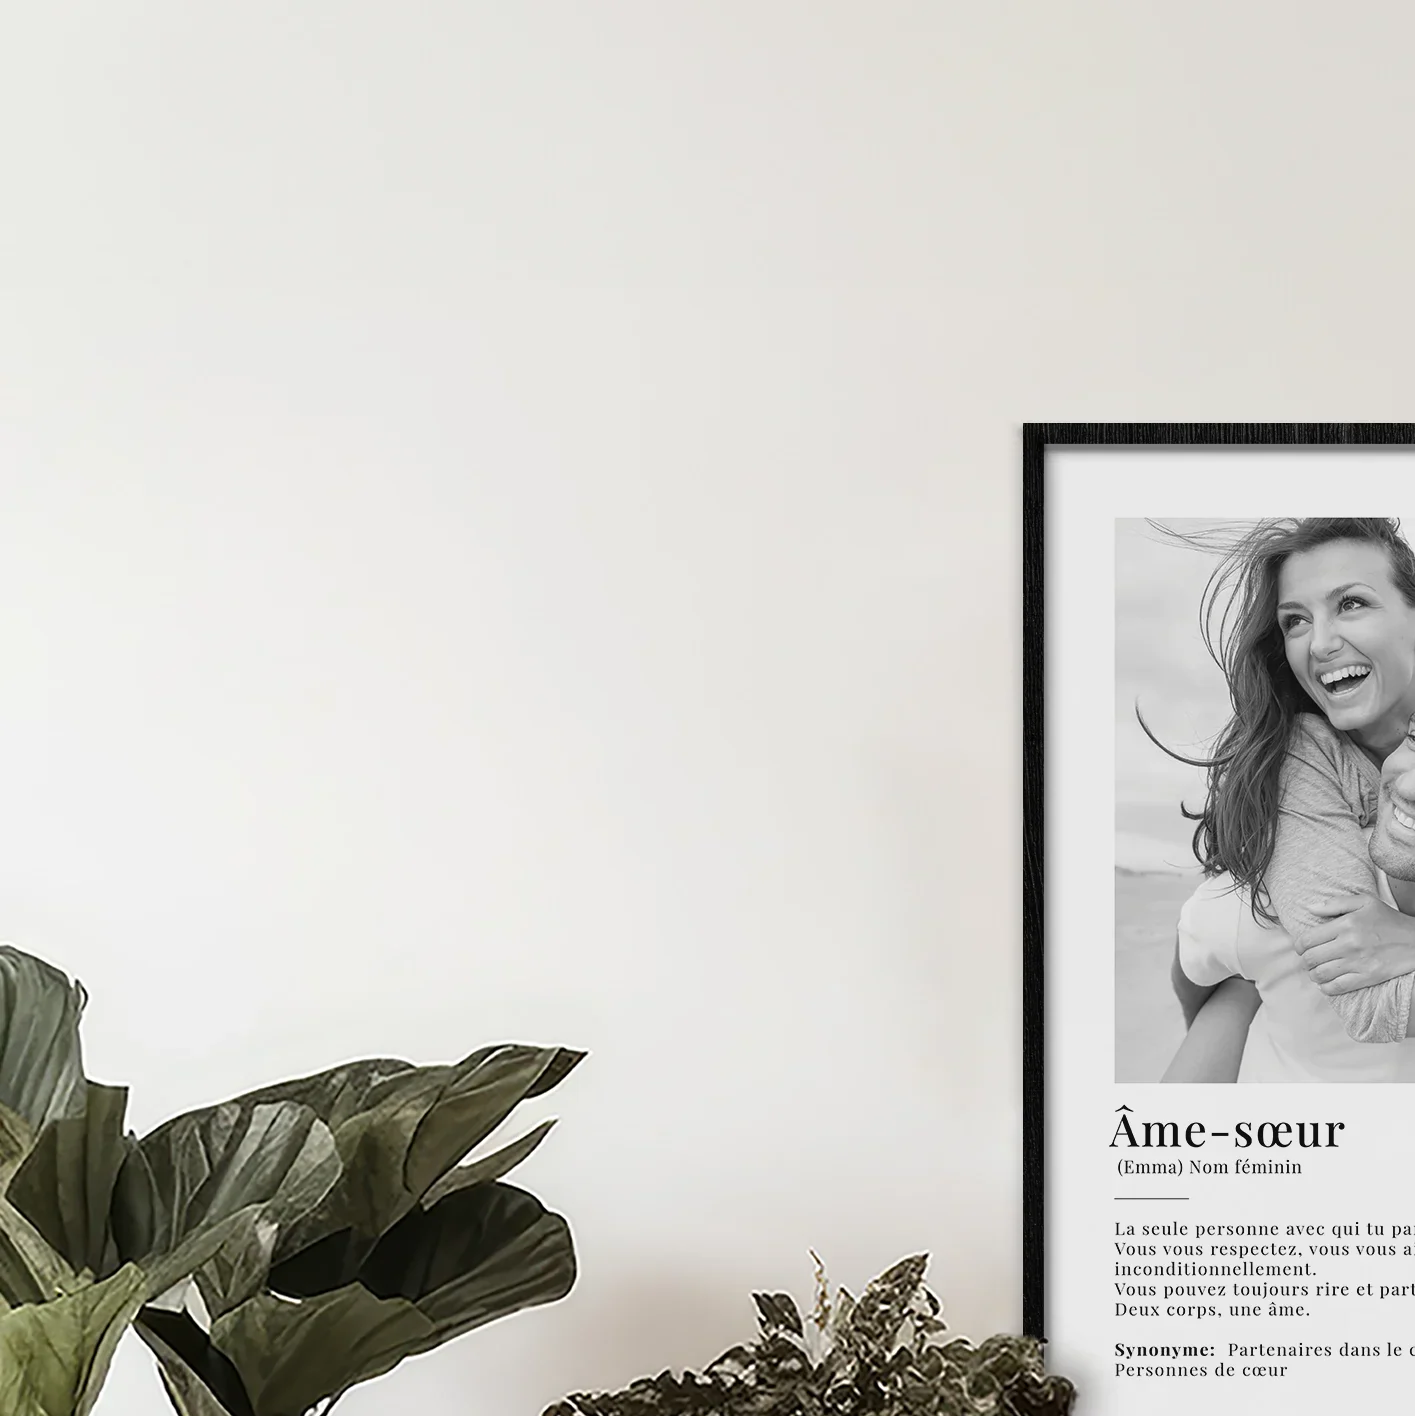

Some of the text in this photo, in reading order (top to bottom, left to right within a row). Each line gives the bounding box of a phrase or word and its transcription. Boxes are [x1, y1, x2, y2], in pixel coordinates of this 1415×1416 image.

[1108, 1104, 1346, 1149] Âme-sœur
[1117, 1158, 1302, 1177] (Emma) Nom féminin
[1115, 1222, 1136, 1236] La
[1141, 1220, 1188, 1236] seule
[1195, 1224, 1279, 1239] personne
[1285, 1224, 1325, 1236] avec
[1331, 1221, 1360, 1239] qui
[1366, 1222, 1385, 1236] tu
[1114, 1242, 1157, 1257] Vous
[1162, 1245, 1204, 1257] vous
[1210, 1242, 1303, 1259] respectez,
[1308, 1245, 1350, 1257] vous
[1355, 1245, 1397, 1257] vous
[1114, 1261, 1317, 1277] inconditionnellement.
[1114, 1282, 1157, 1297] Vous
[1163, 1285, 1226, 1300] pouvez
[1233, 1281, 1309, 1300] toujours
[1315, 1281, 1350, 1297] rire
[1356, 1283, 1374, 1297] et
[1115, 1301, 1310, 1320] Deux corps, une âme.
[1114, 1342, 1215, 1360] Synonyme:
[1228, 1342, 1332, 1357] Partenaires
[1339, 1341, 1381, 1357] dans
[1386, 1341, 1403, 1357] le
[1115, 1361, 1288, 1377] Personnes de cœur
